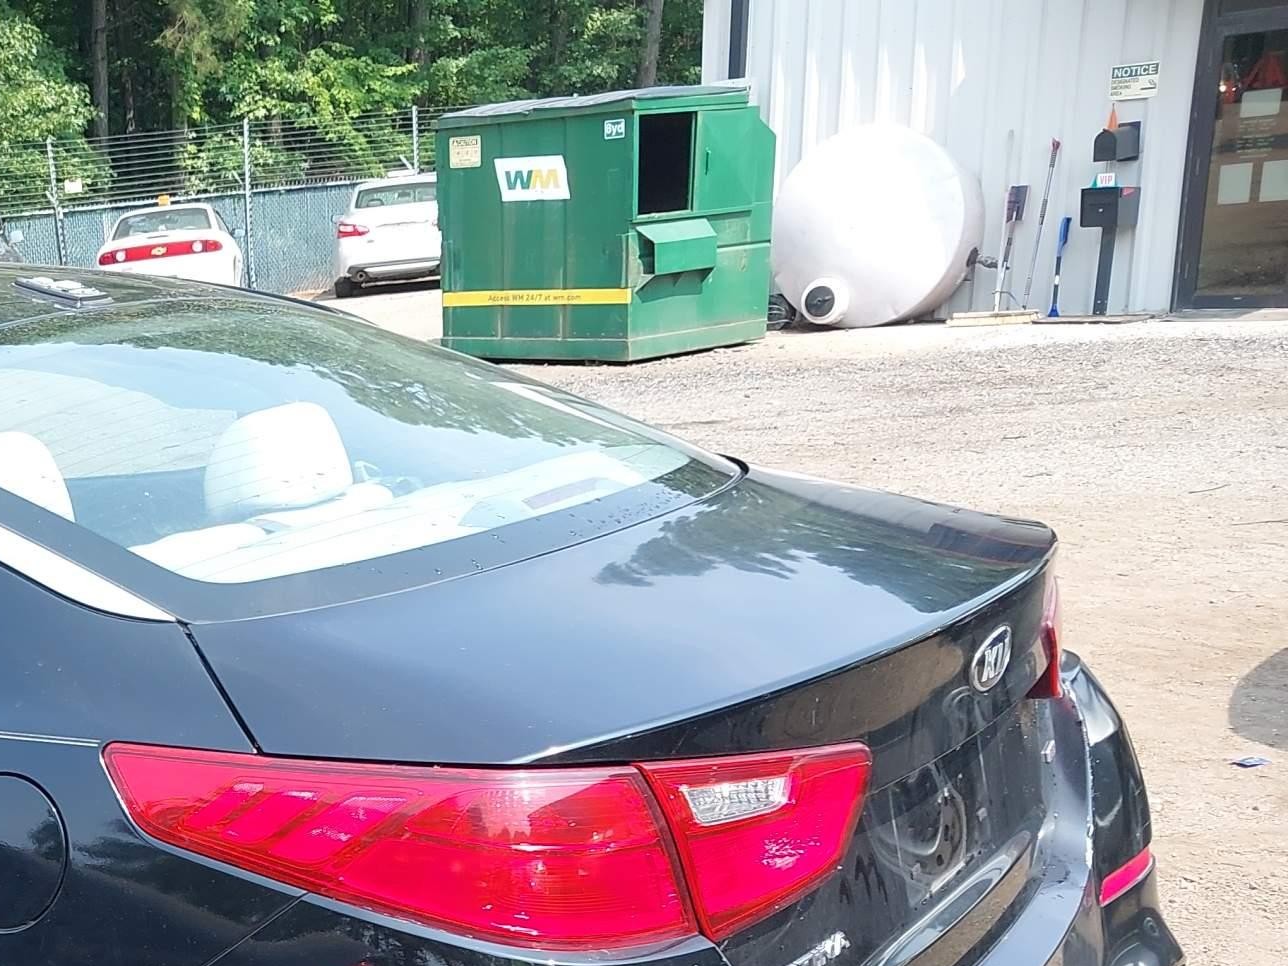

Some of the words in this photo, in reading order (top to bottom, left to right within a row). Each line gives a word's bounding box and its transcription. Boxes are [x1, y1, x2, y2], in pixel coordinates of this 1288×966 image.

[1113, 65, 1157, 77] NOTICE
[505, 168, 560, 190] WM
[1100, 176, 1112, 184] VIP
[512, 294, 524, 302] WM
[526, 293, 542, 302] 24/7
